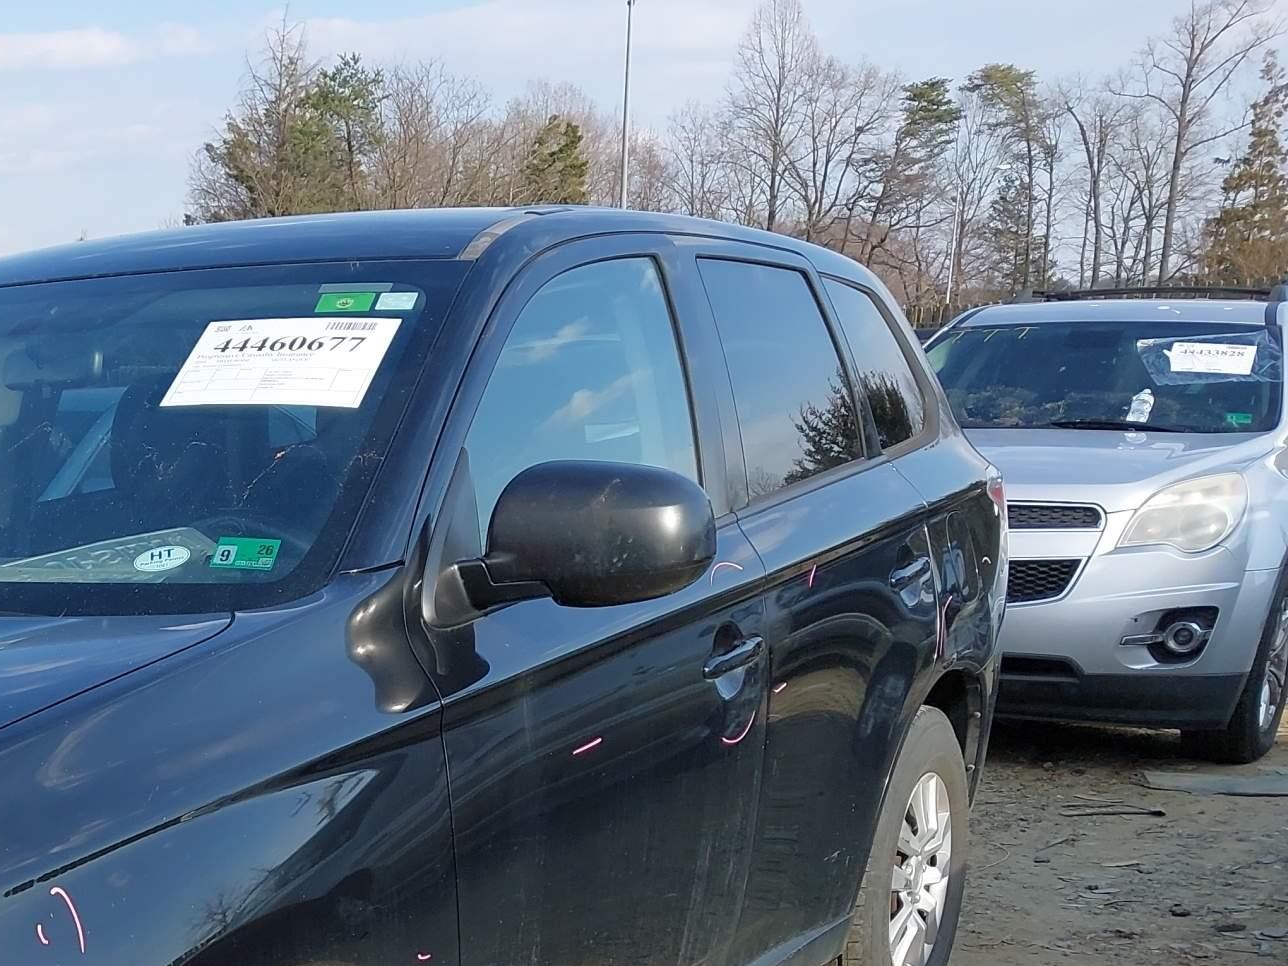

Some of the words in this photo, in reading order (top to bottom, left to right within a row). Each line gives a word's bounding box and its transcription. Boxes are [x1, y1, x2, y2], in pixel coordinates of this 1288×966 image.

[213, 335, 367, 353] 44460677
[150, 548, 175, 561] HT
[219, 549, 231, 562] 9
[257, 545, 274, 556] 26
